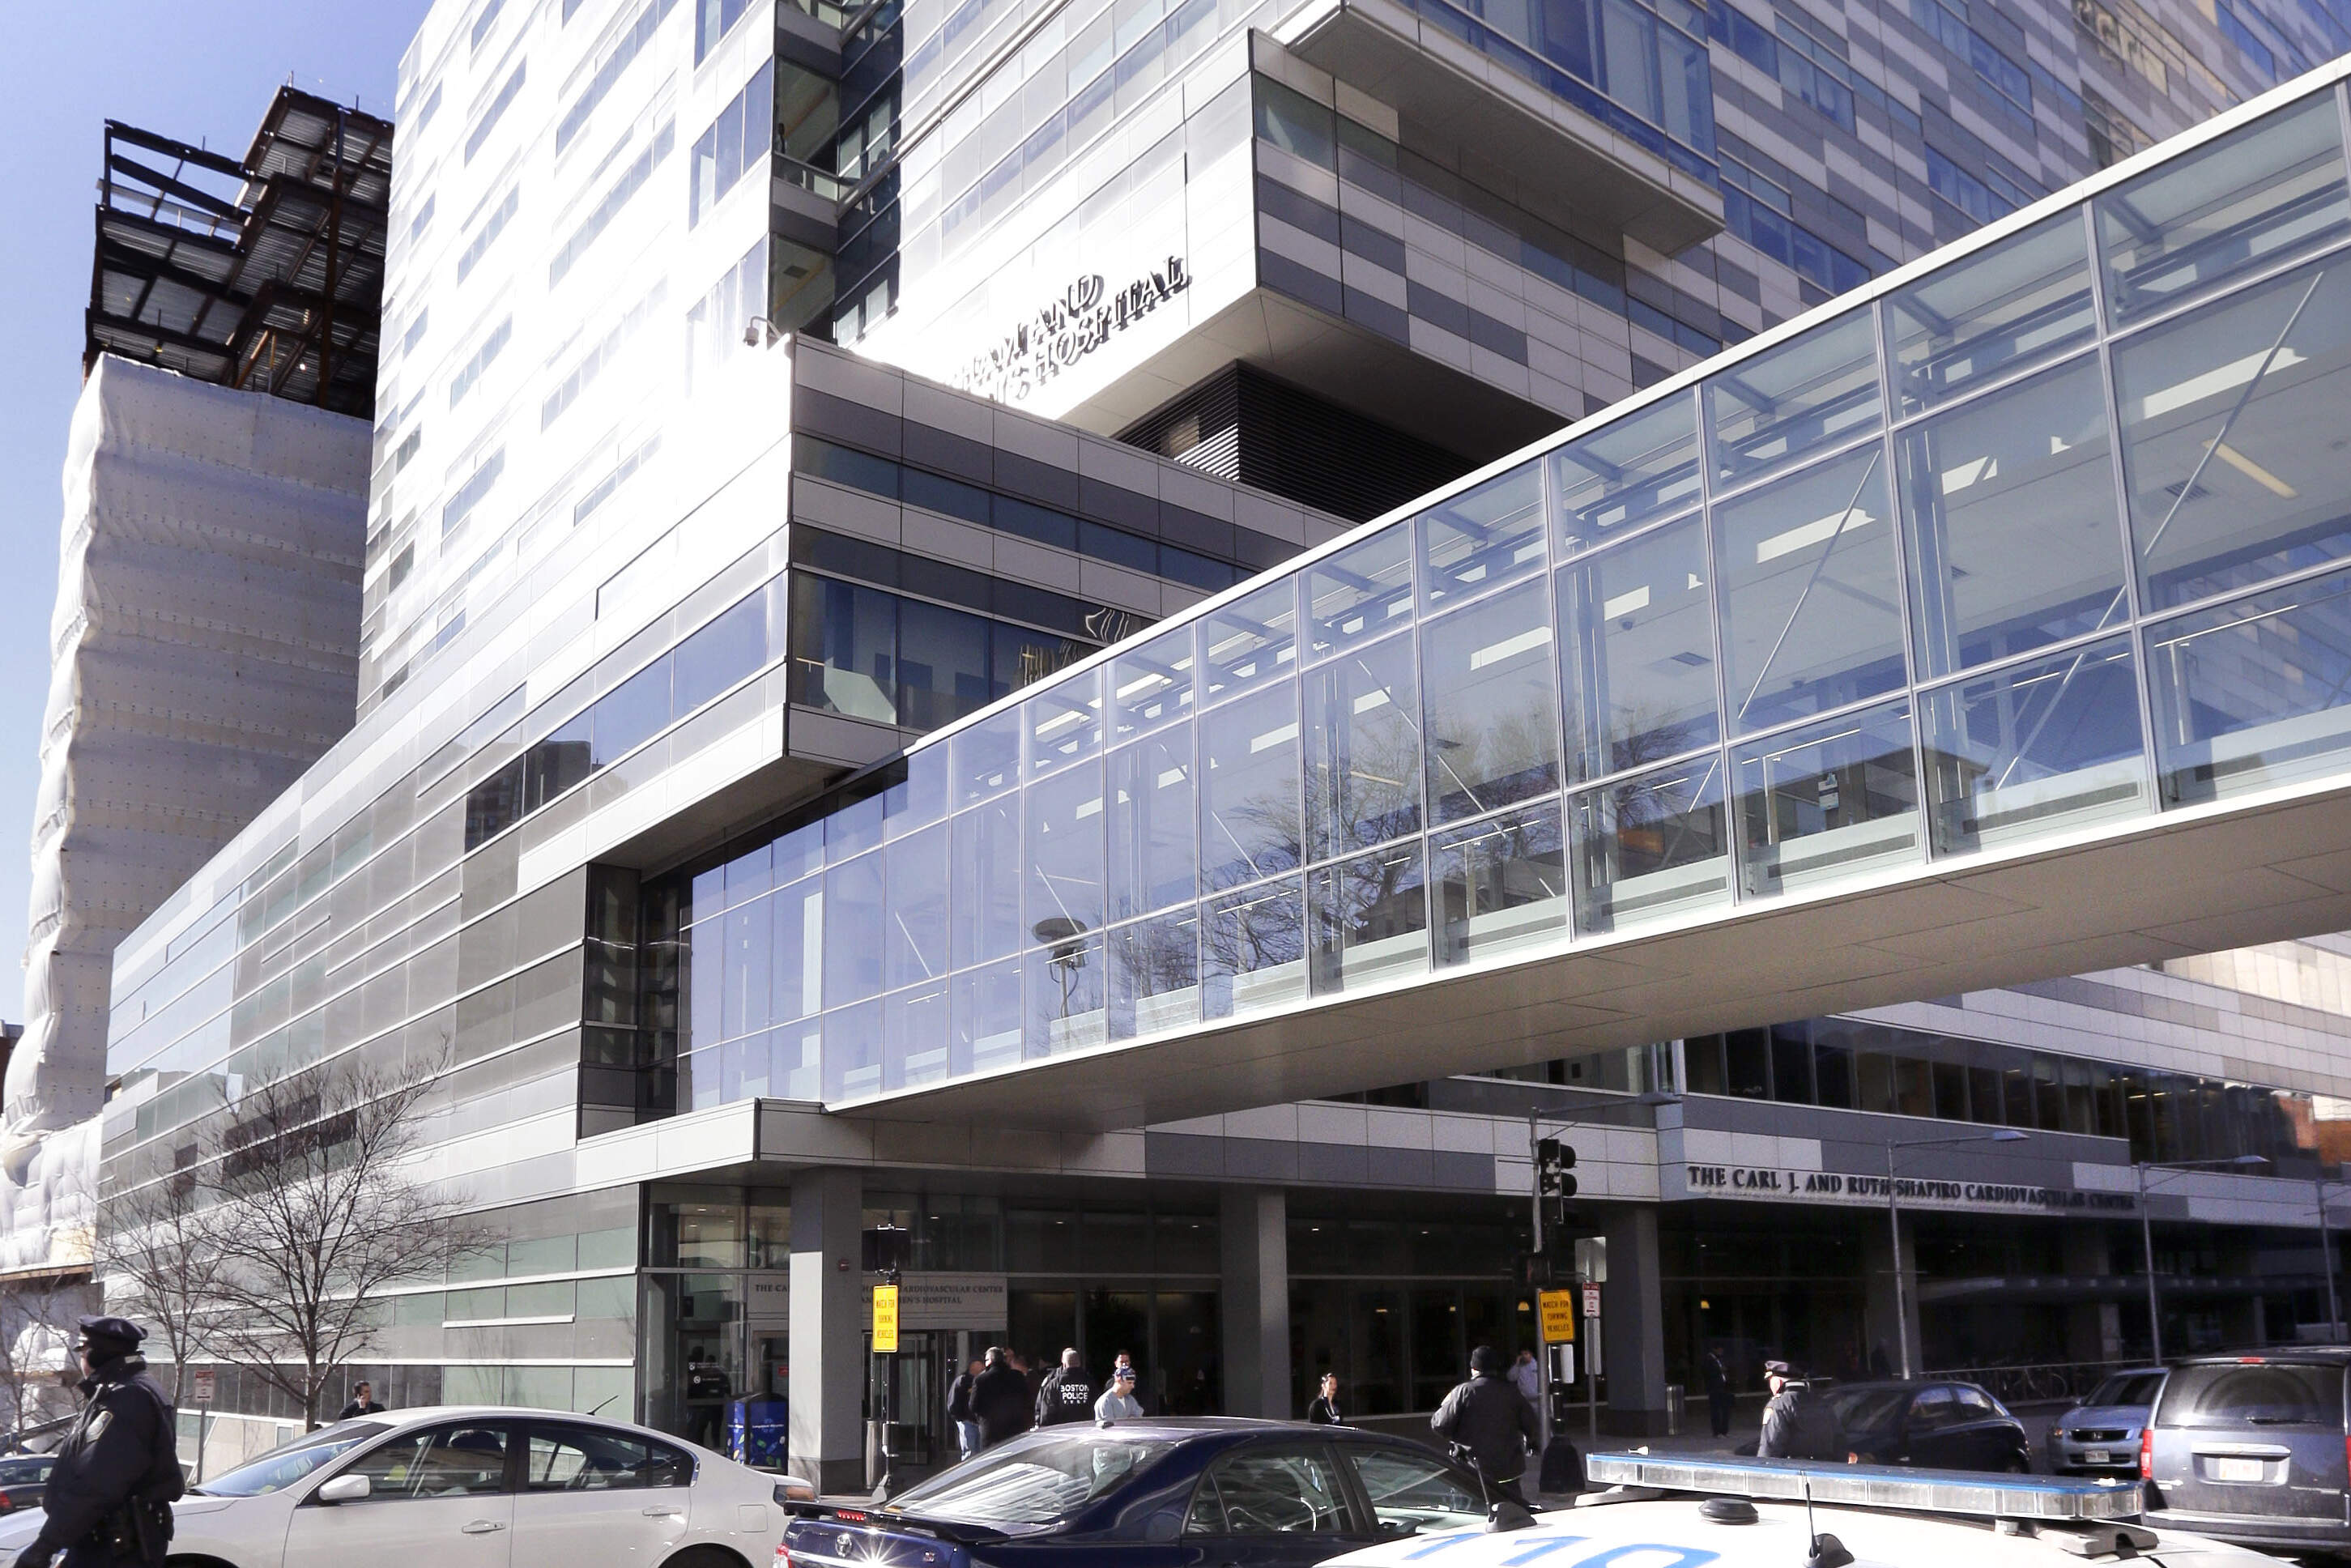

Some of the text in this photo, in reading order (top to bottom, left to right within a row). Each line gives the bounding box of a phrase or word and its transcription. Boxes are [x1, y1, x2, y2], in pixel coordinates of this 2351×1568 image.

[1030, 274, 1105, 346] AND
[1035, 255, 1193, 386] HOSPITAL
[1688, 1166, 1727, 1187] THE
[1731, 1169, 1782, 1190] CARL
[1788, 1172, 1800, 1194] J.
[1805, 1174, 1842, 1194] AND
[1847, 1176, 1890, 1195] RUTH
[1895, 1178, 1961, 1200] SHAPIRO
[1964, 1183, 2085, 1208] CARDIOVASCULAR
[756, 1284, 788, 1292] THE CA
[902, 1285, 971, 1293] ARDIOVASCULAR
[922, 1296, 962, 1304] HOSPITAL
[1060, 1384, 1089, 1392] BOSTON
